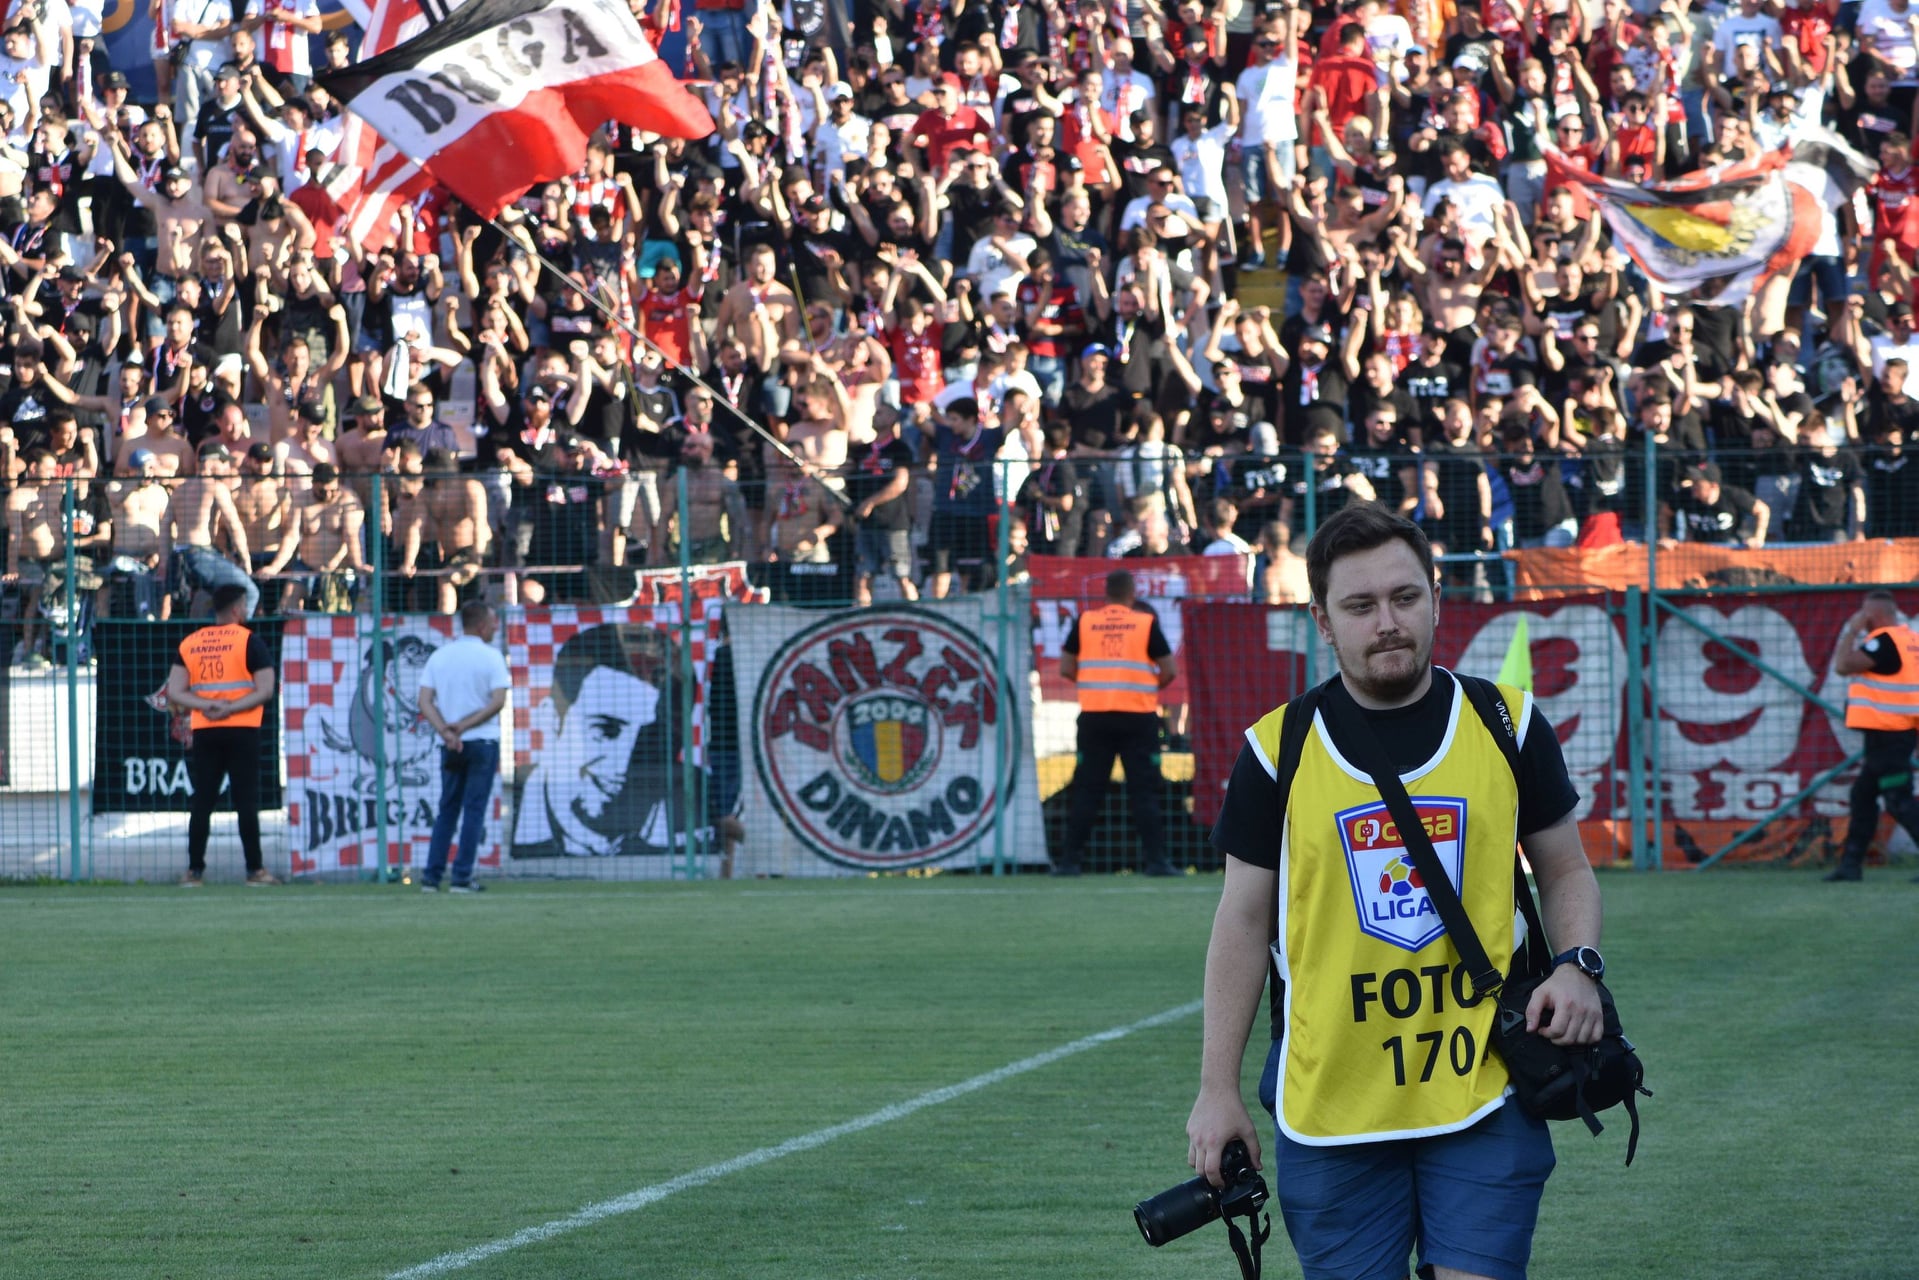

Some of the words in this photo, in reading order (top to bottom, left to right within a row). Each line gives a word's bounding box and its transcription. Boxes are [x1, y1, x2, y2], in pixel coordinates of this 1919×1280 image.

[199, 661, 225, 680] 219
[124, 757, 230, 796] BRA
[305, 788, 487, 851] BRIGA
[797, 771, 983, 851] DINAMO
[1381, 814, 1452, 842] csa
[1372, 896, 1437, 921] LIGA
[1350, 961, 1485, 1023] FOTO
[1382, 1025, 1476, 1086] 170
